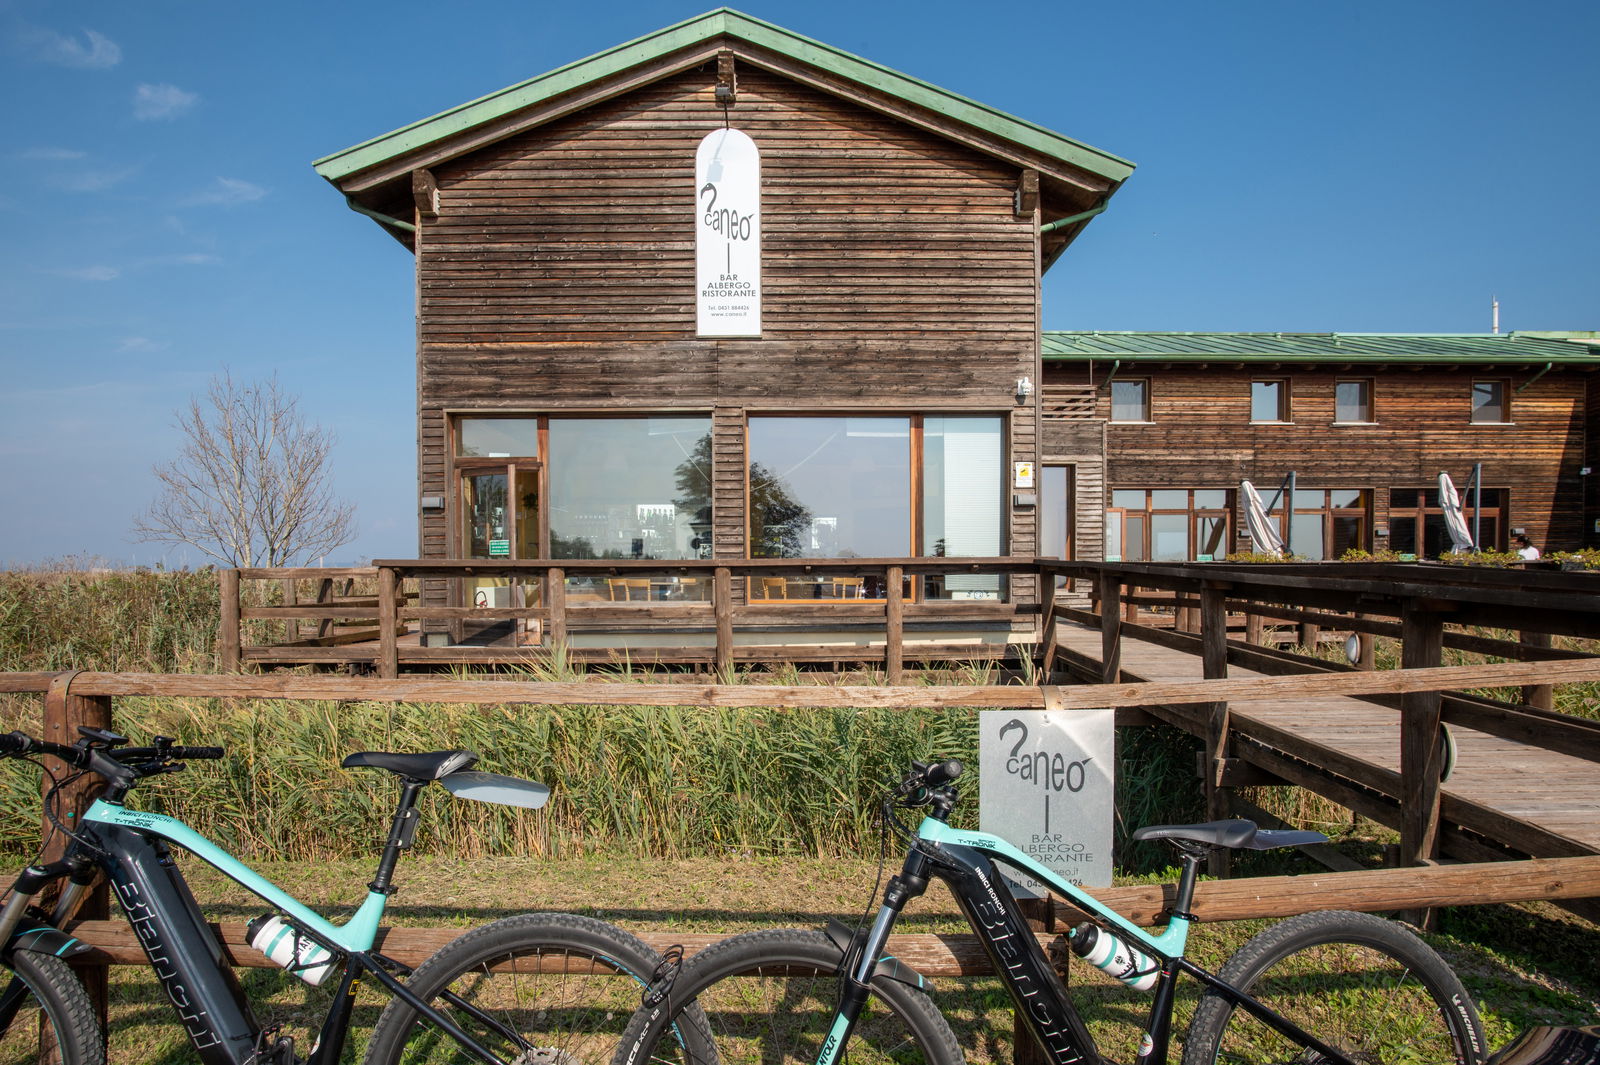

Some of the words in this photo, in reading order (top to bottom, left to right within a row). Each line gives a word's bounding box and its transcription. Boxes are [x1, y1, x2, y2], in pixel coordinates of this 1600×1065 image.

[707, 281, 751, 290] ALBERGO
[702, 289, 757, 298] RISTORANTE
[142, 814, 172, 823] RONCHI
[1031, 833, 1063, 844] BAR
[1013, 843, 1085, 854] LBERGO
[974, 866, 991, 889] INBICI
[987, 887, 1007, 916] RONCHI
[1457, 1005, 1481, 1054] MICHELIN
